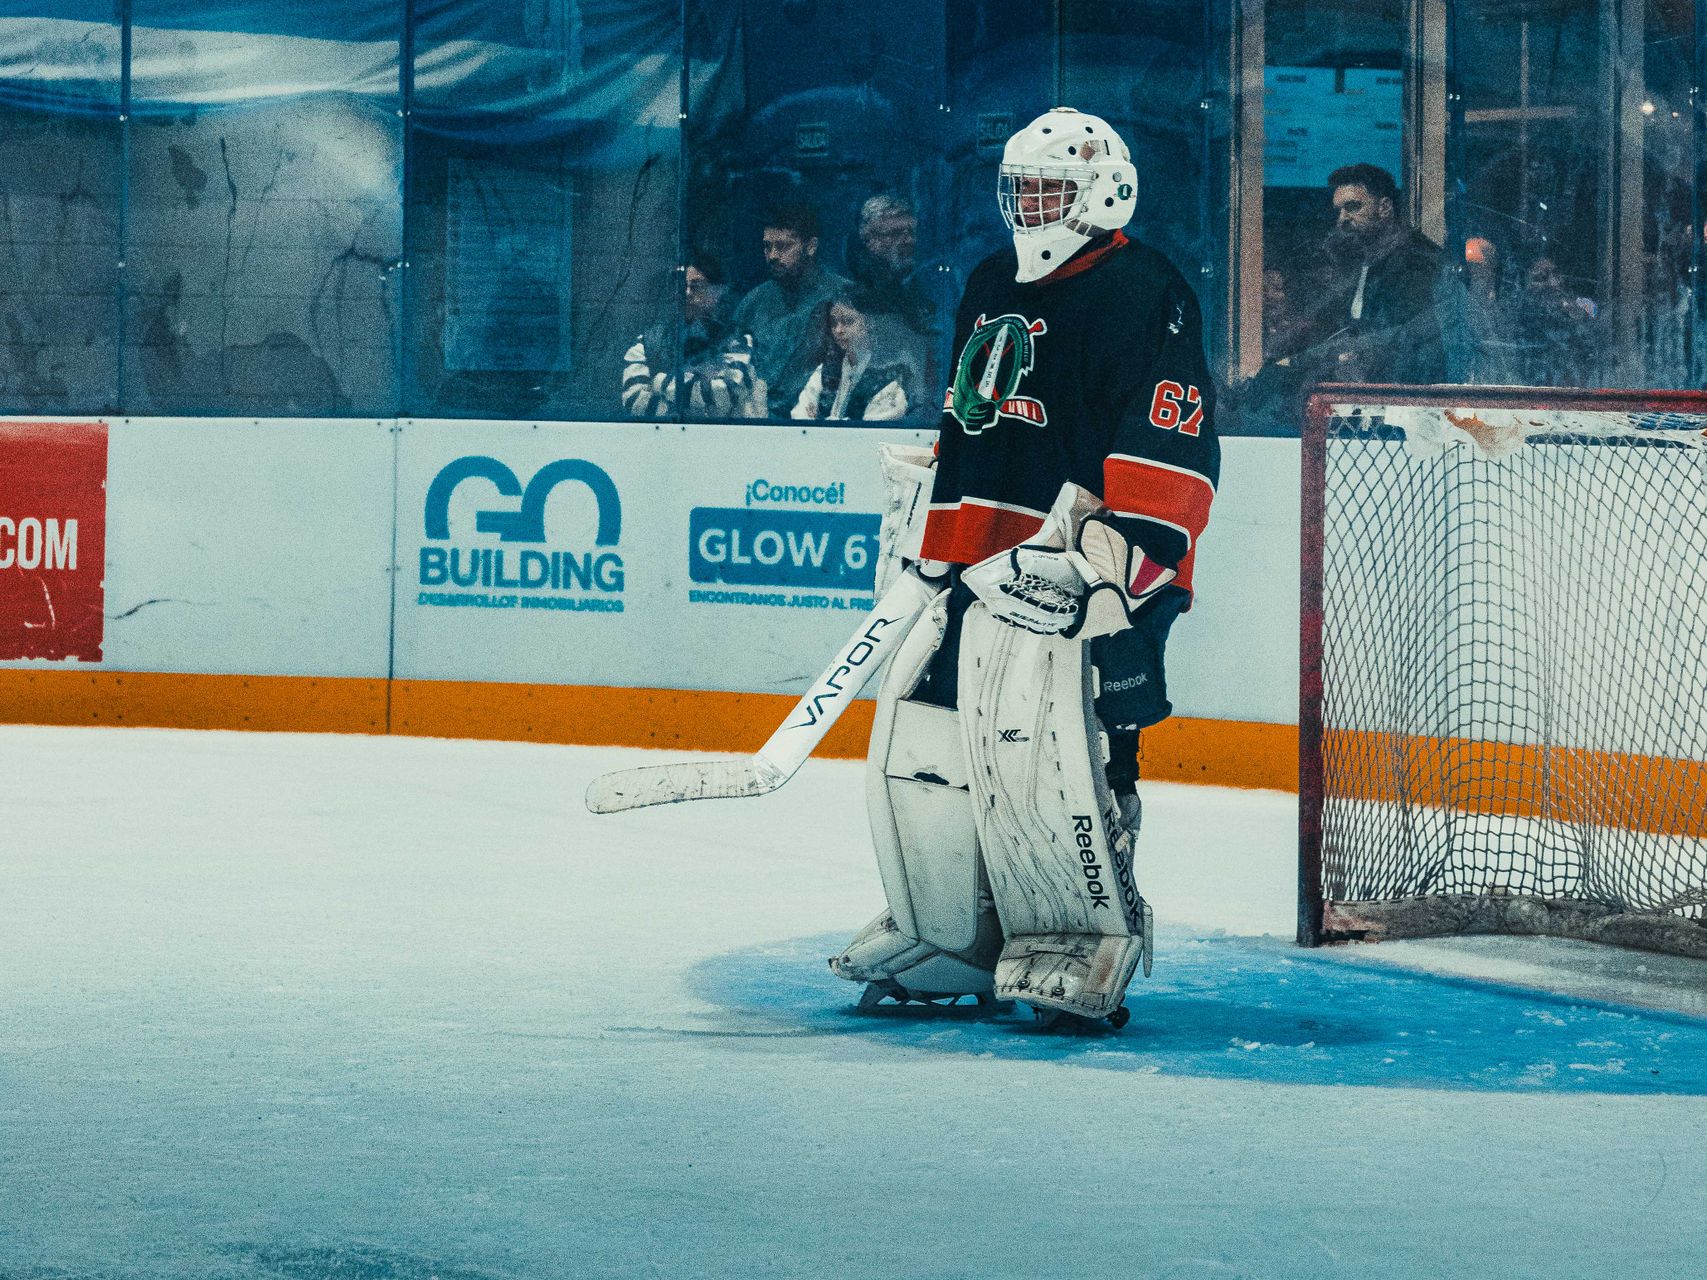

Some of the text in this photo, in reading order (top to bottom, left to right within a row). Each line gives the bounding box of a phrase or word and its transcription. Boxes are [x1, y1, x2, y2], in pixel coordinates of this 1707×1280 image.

[424, 455, 622, 547] GO
[745, 479, 846, 507] ¡Conocé!
[419, 546, 625, 593] BUILDING
[698, 527, 880, 570] GLOW 6
[787, 594, 830, 609] JUSTO
[831, 597, 848, 610] AL
[785, 616, 905, 730] VAPOR
[1103, 672, 1149, 693] Reebok
[1071, 814, 1110, 911] Reebok
